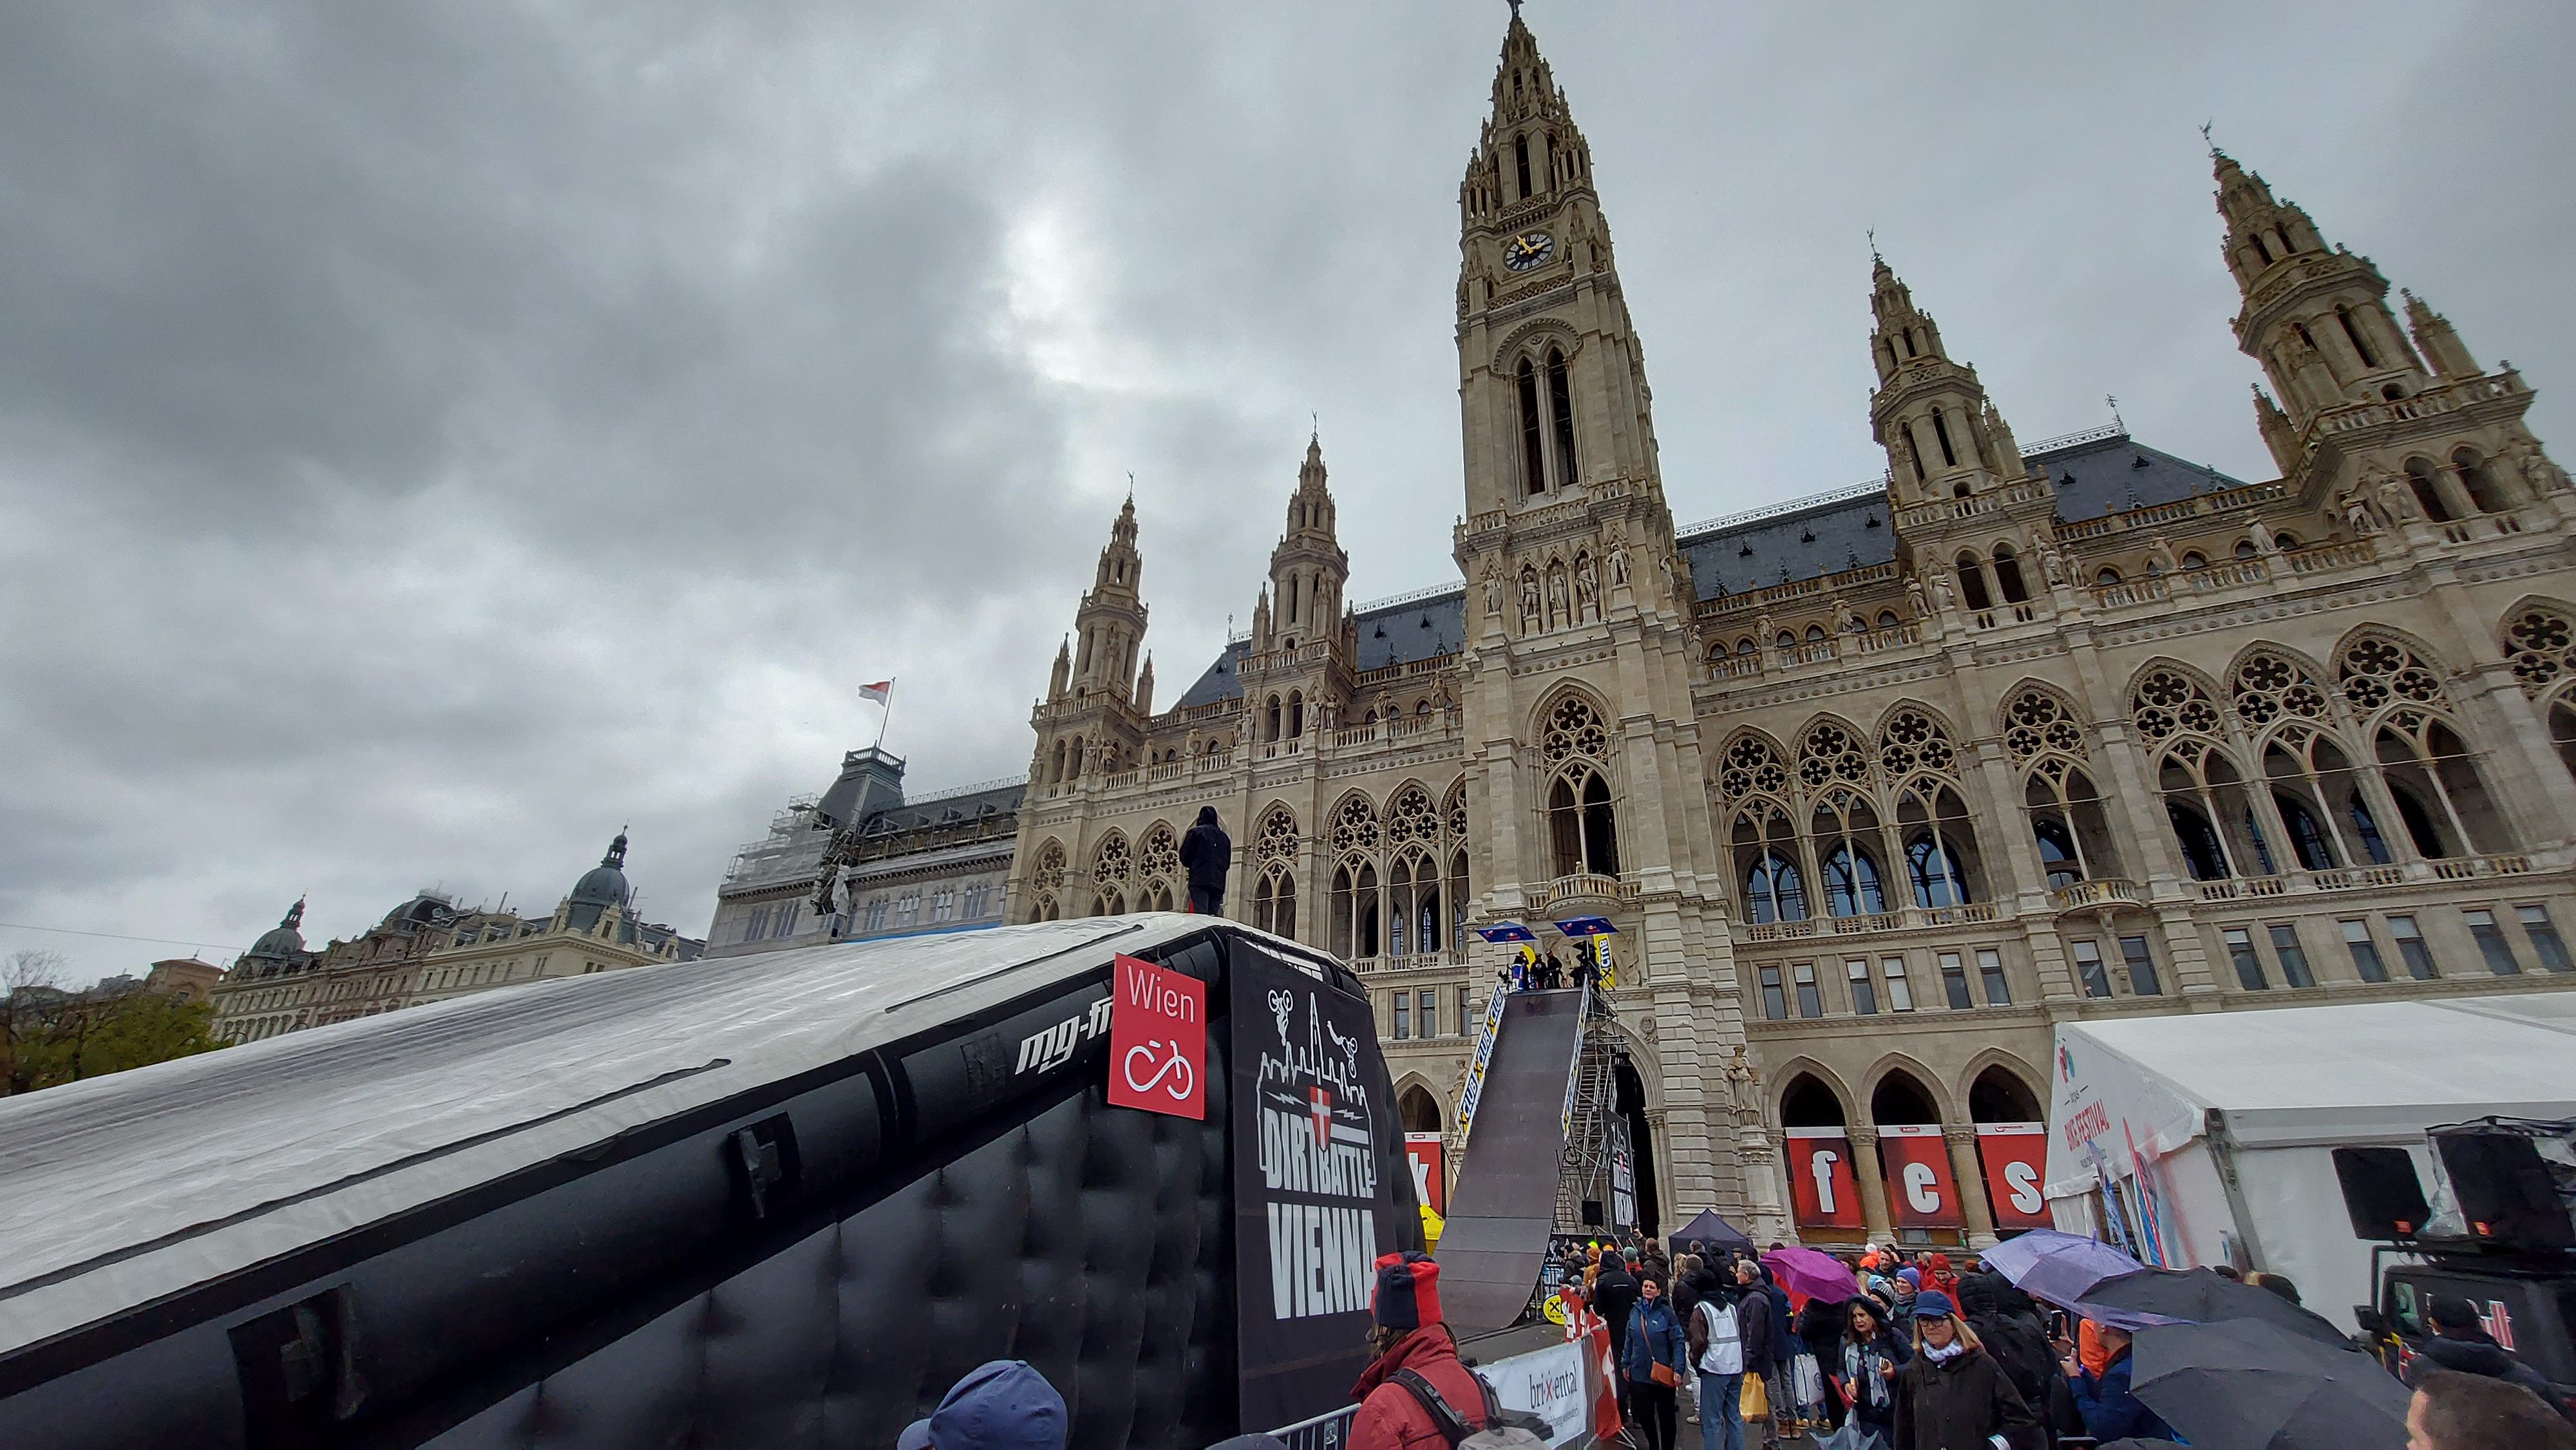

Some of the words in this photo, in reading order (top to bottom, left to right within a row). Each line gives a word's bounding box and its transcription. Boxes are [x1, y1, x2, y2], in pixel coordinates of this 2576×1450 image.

[1128, 965, 1195, 1022] Wien
[1463, 1077, 1477, 1118] CLUB
[2075, 1098, 2110, 1144] FESTIVAL
[1264, 1107, 1319, 1193] DIRT
[1320, 1142, 1374, 1198] BATTLE
[1267, 1202, 1378, 1320] VIENNA
